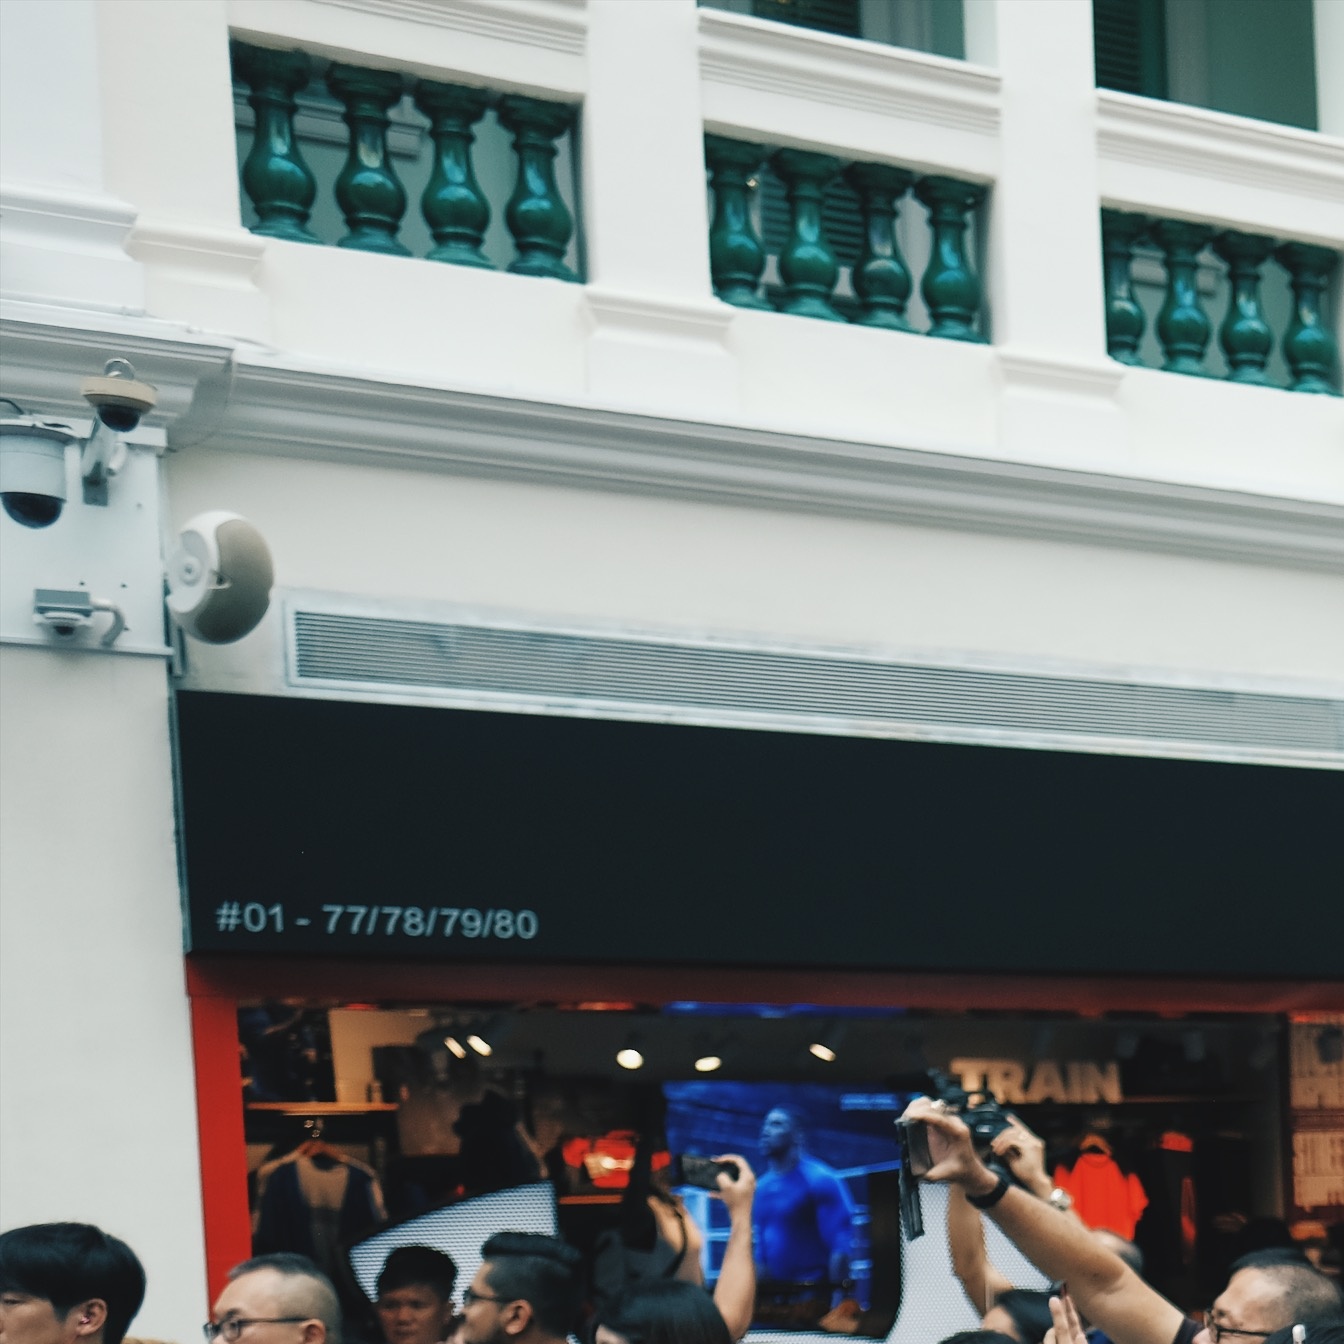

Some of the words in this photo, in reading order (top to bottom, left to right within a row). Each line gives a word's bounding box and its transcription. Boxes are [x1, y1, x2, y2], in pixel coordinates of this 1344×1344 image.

[215, 901, 285, 933] #01
[321, 903, 539, 940] 77/78/79/80
[950, 1057, 1123, 1105] TRAIN
